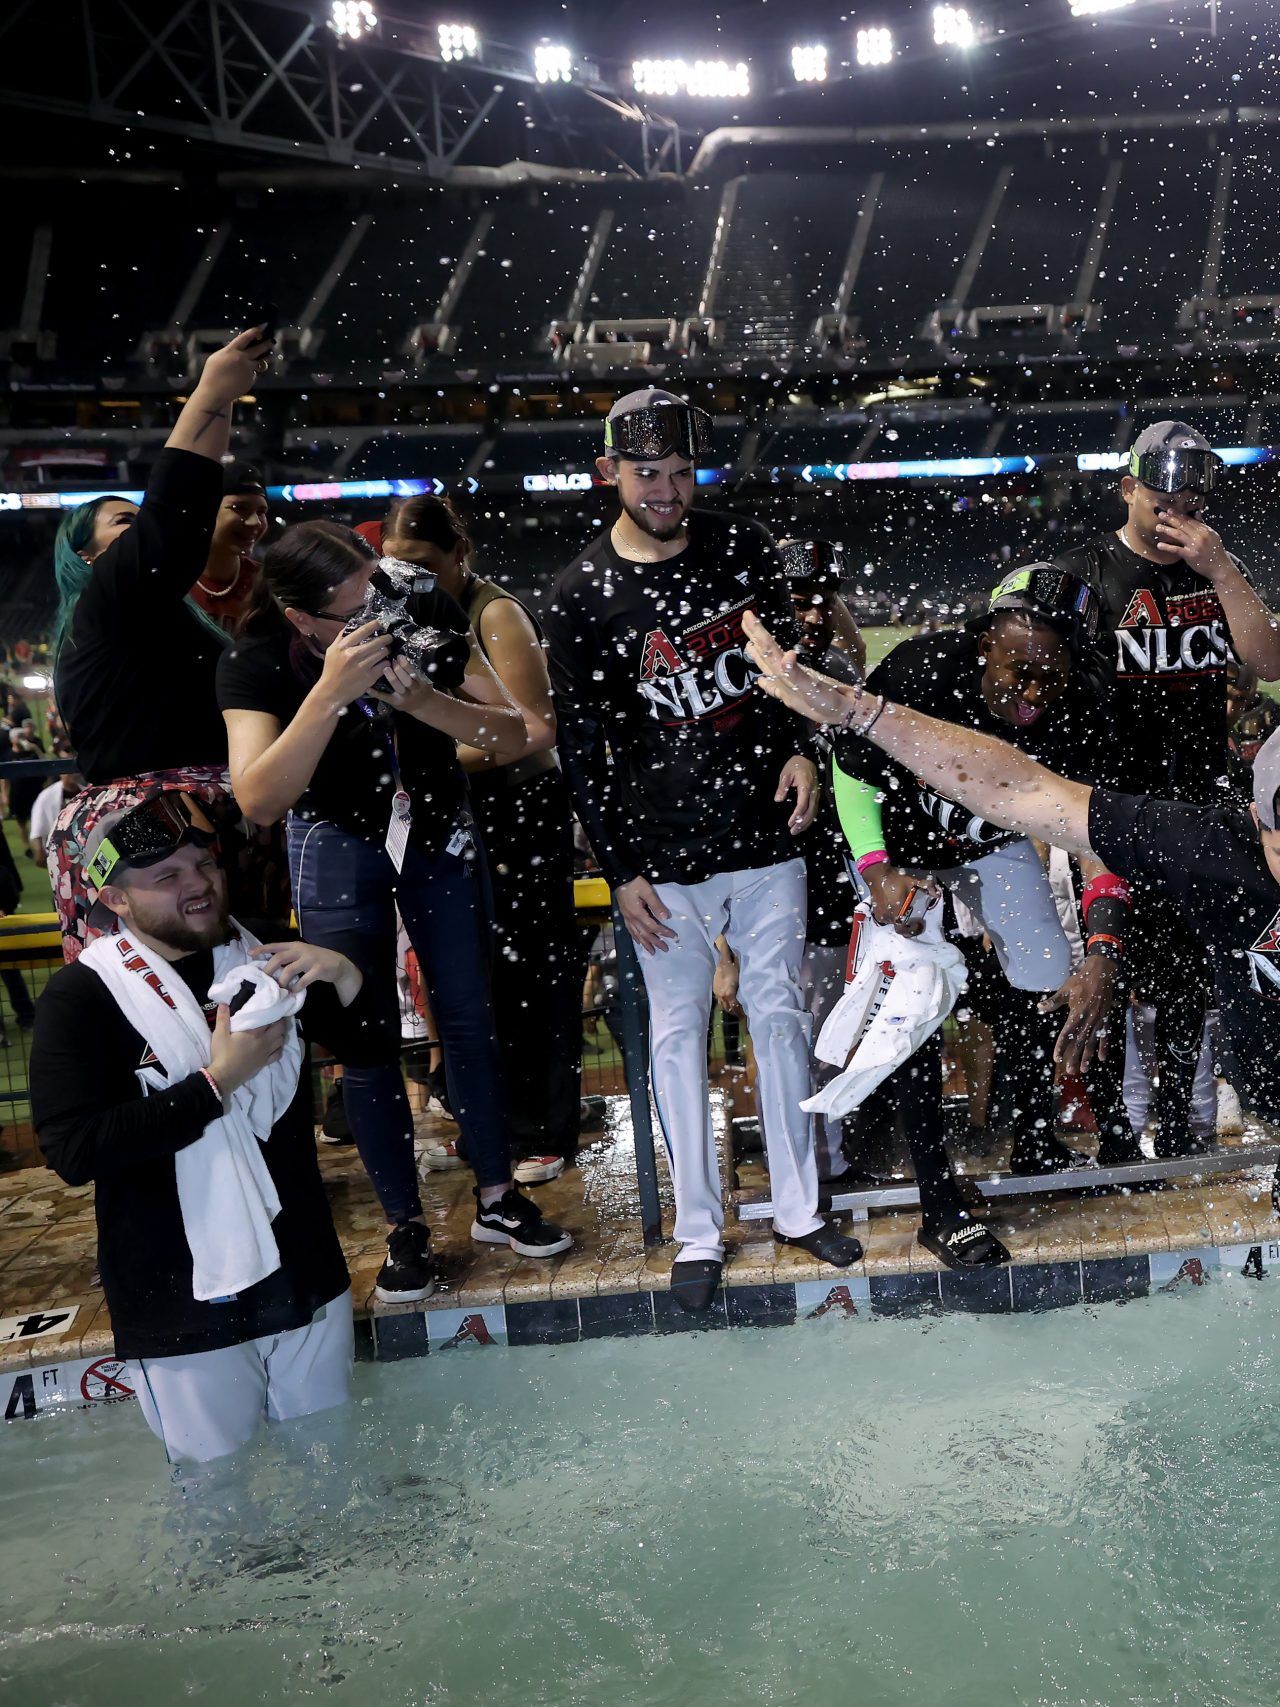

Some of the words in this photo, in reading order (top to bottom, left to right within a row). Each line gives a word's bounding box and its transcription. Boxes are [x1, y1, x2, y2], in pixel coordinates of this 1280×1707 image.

[548, 473, 593, 490] NLCS
[682, 617, 711, 635] ARIZONA
[1114, 625, 1242, 672] NLCS
[42, 1368, 58, 1386] FT
